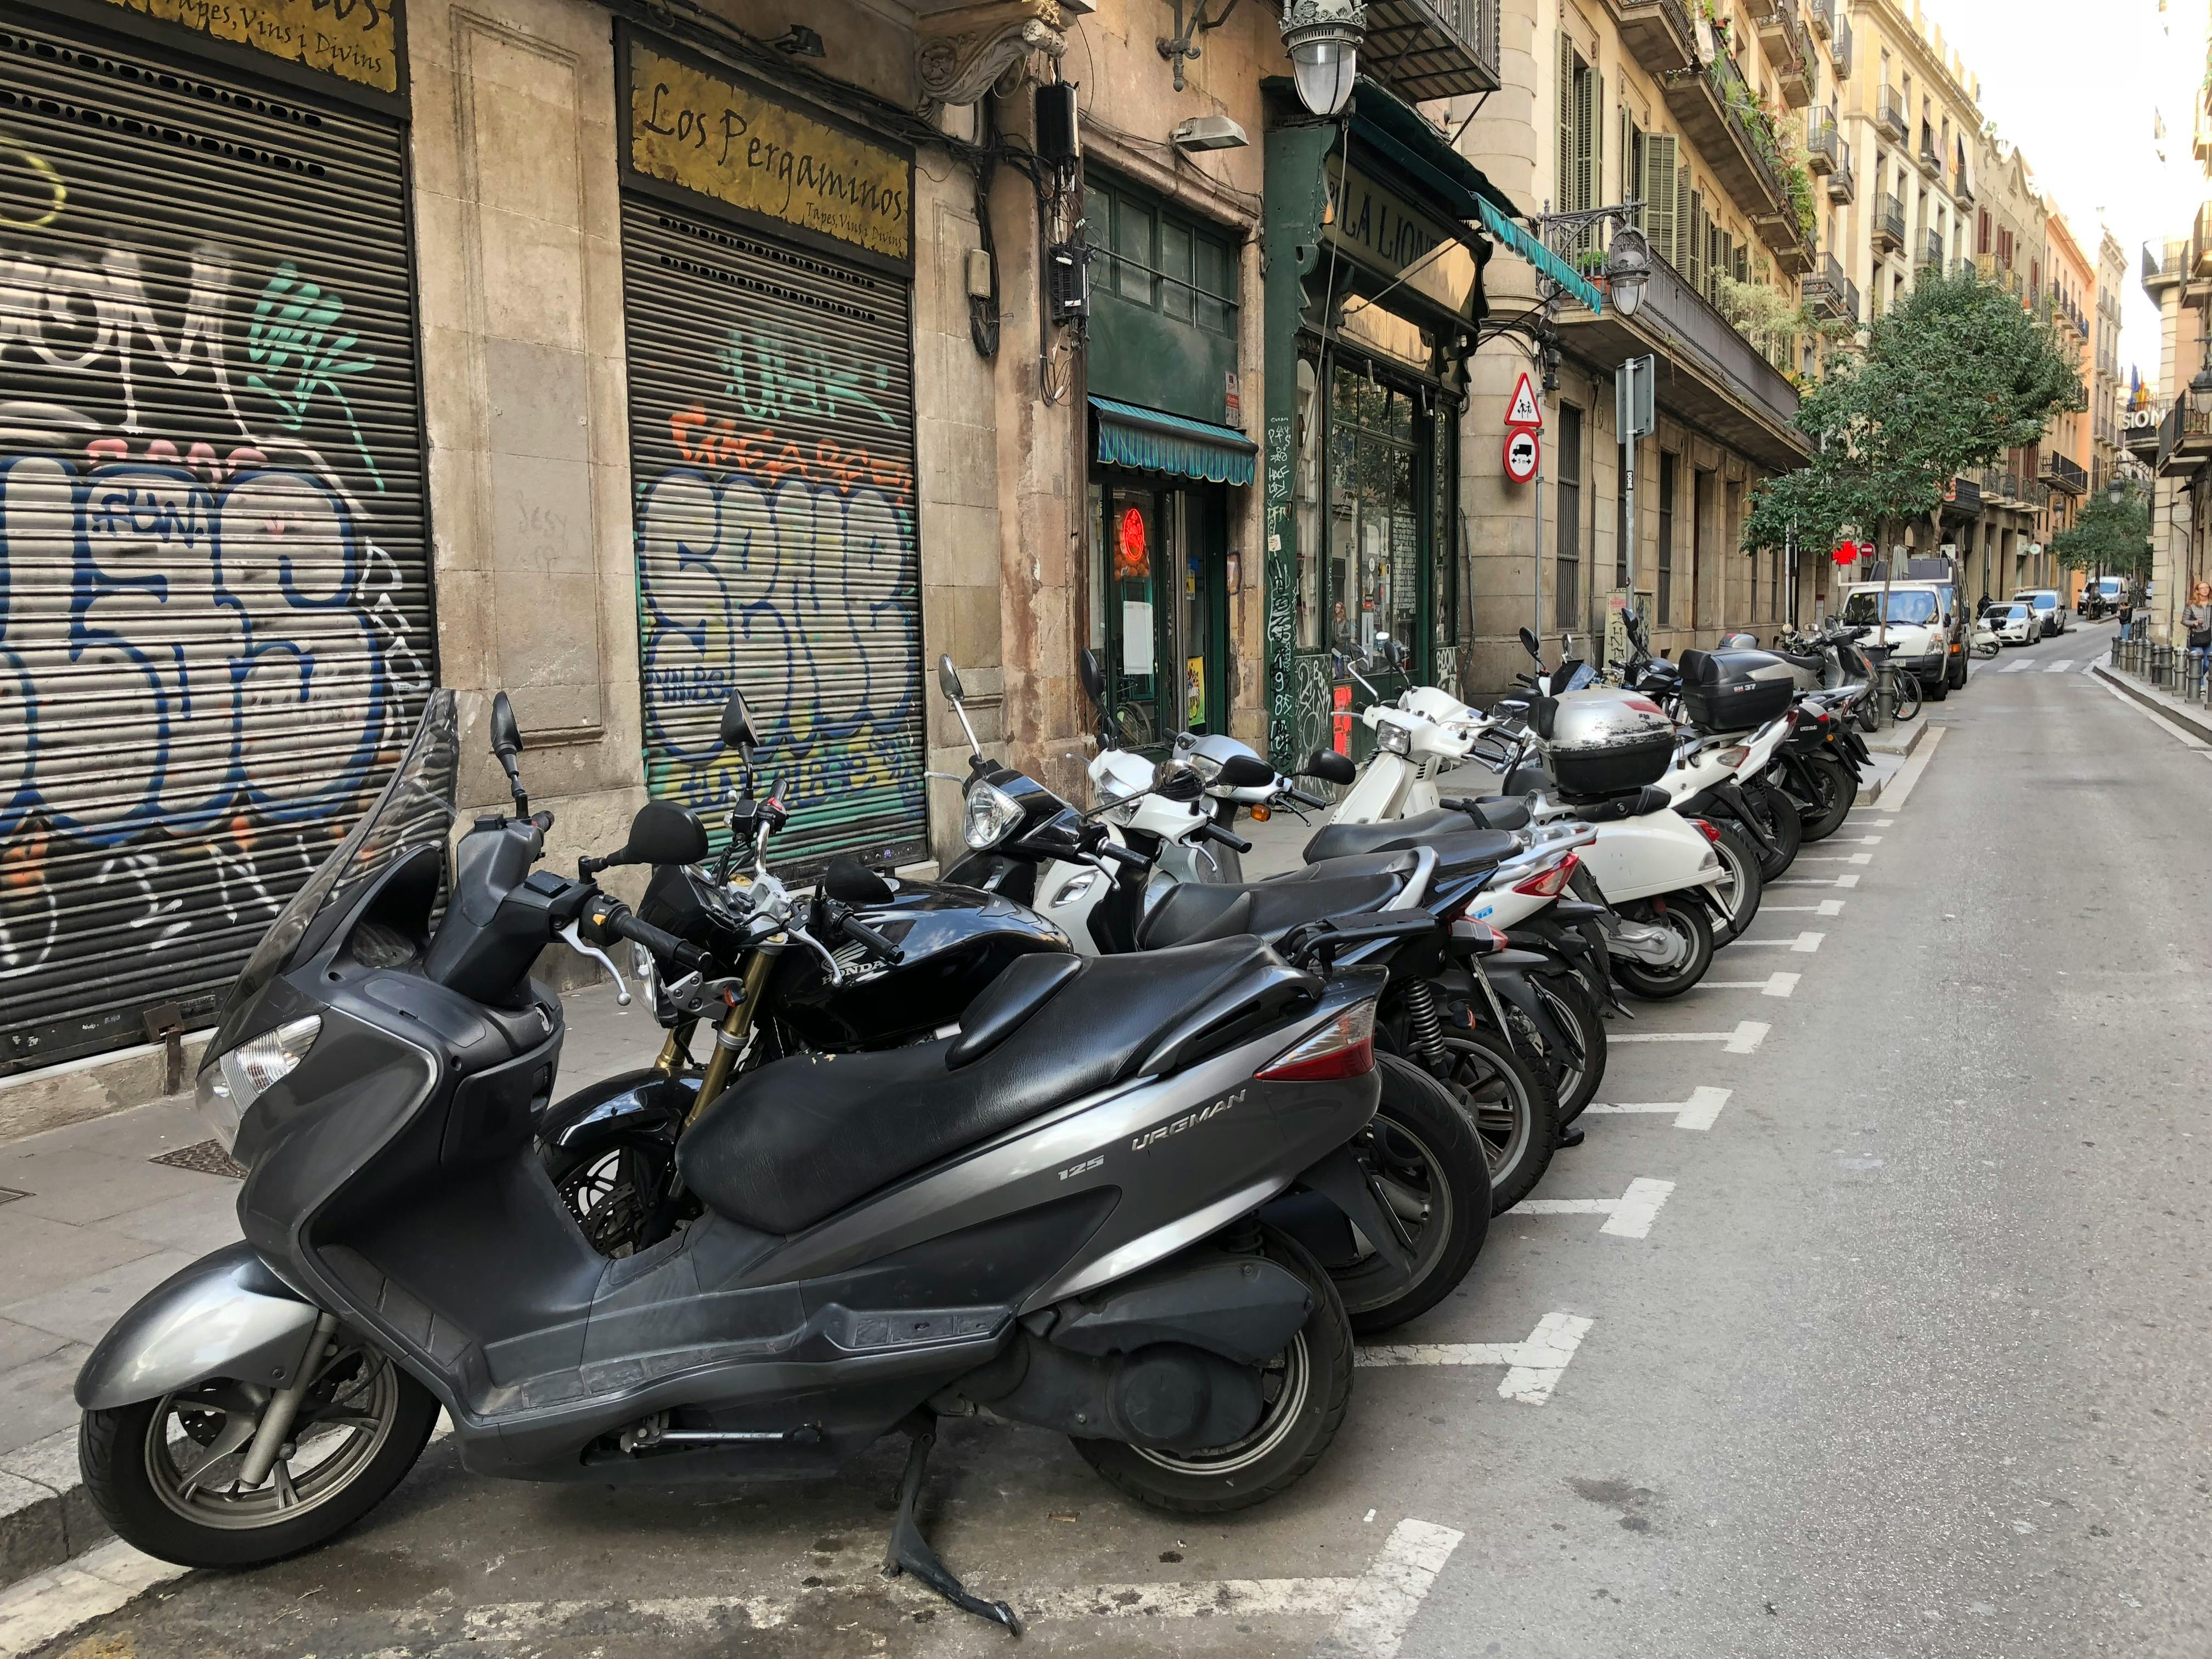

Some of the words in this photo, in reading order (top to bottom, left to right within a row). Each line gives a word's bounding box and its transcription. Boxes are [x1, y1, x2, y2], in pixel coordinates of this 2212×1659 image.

[166, 0, 236, 30] apes,
[239, 7, 291, 42] Vins
[298, 25, 307, 48] i
[315, 32, 381, 72] Divins
[643, 82, 707, 148] Los
[718, 109, 902, 221] Pergaminos
[806, 202, 837, 232] Tapes,
[839, 214, 861, 235] Vins
[872, 225, 902, 247] Divins
[2122, 409, 2166, 430] SION
[1745, 683, 1756, 691] 37
[1058, 1154, 1104, 1181] 125
[1131, 1089, 1247, 1152] URGMAN
